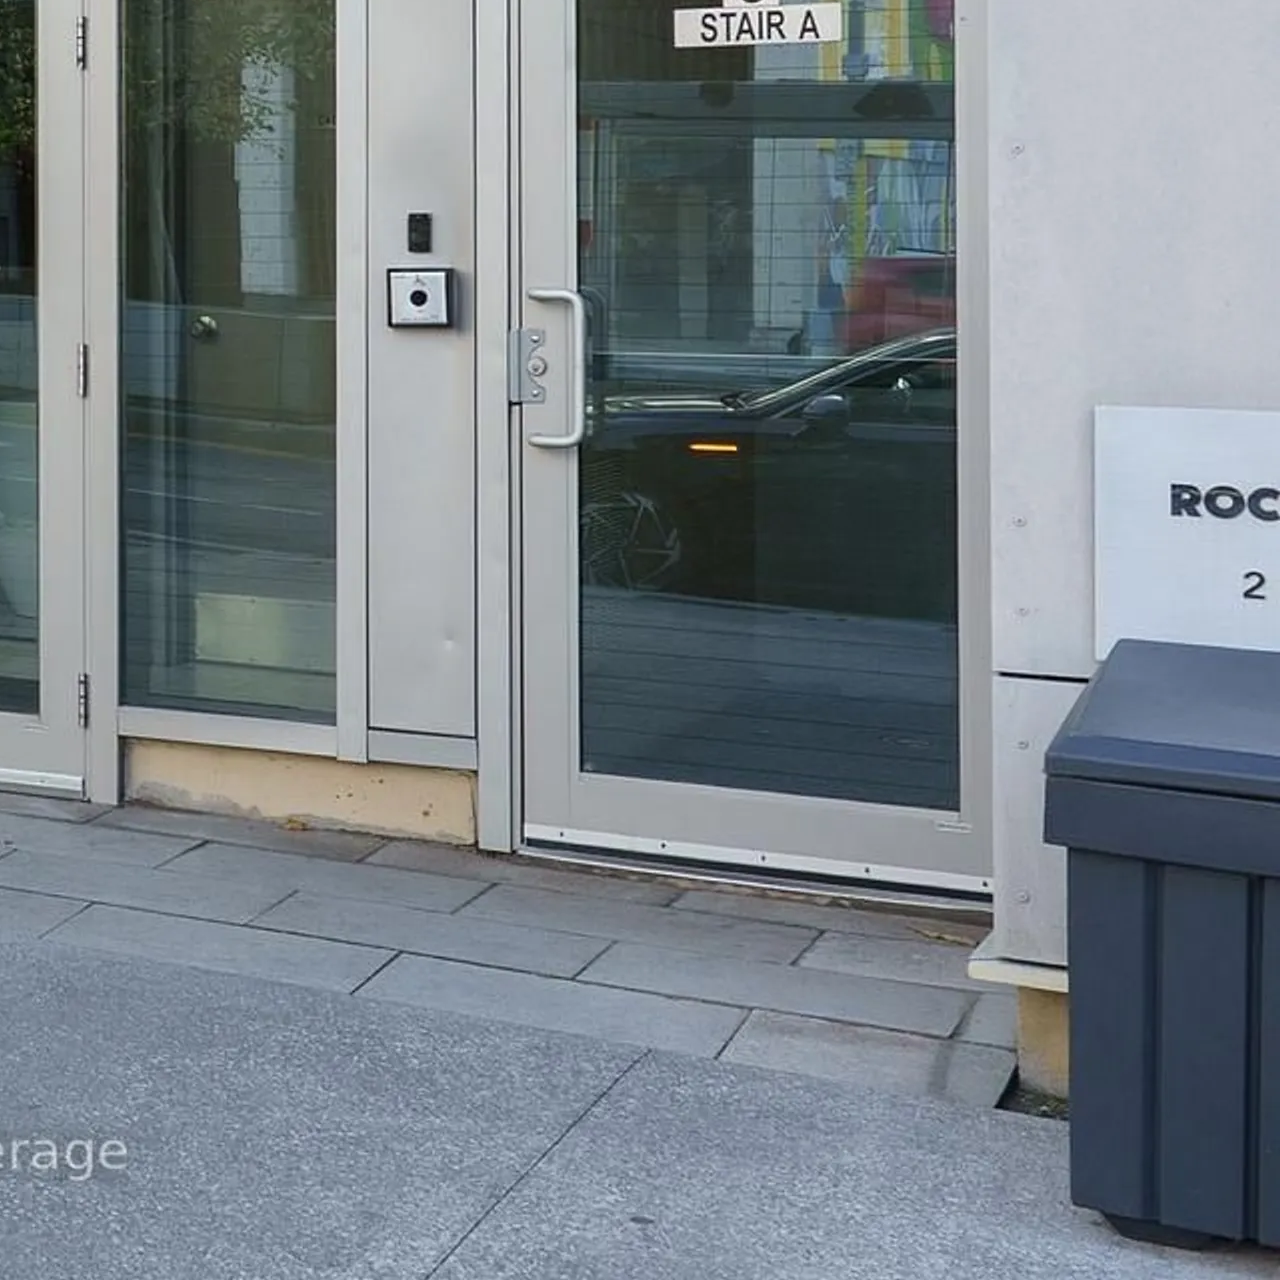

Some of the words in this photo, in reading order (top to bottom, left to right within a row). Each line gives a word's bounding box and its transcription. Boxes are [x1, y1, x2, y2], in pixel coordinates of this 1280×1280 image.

[700, 10, 786, 43] STAIR
[799, 10, 820, 40] A
[1169, 483, 1280, 522] ROC
[1243, 571, 1266, 600] 2
